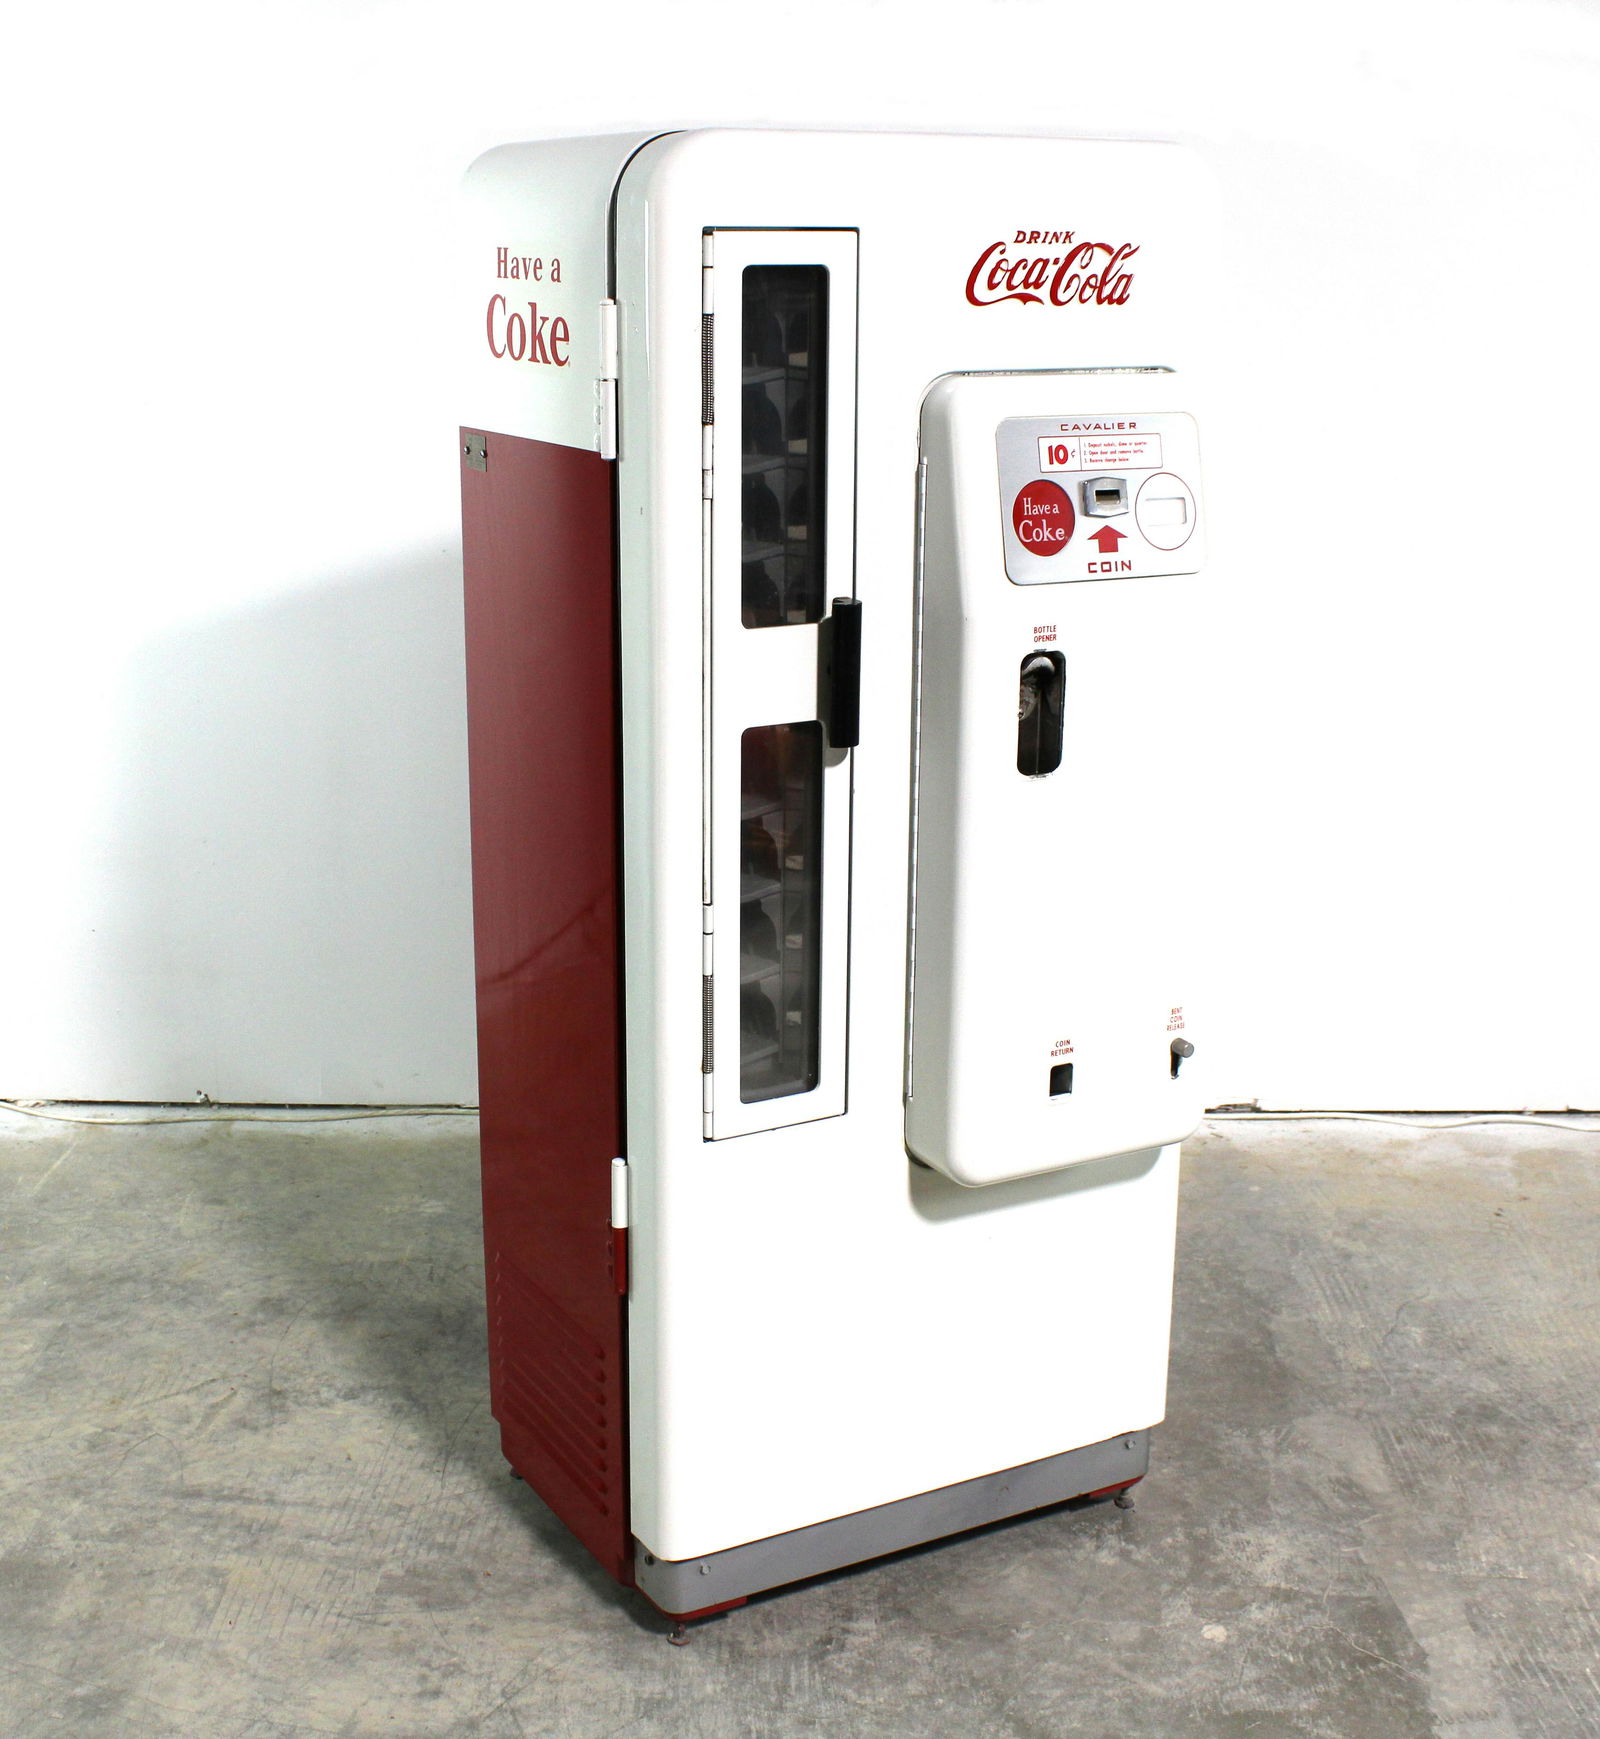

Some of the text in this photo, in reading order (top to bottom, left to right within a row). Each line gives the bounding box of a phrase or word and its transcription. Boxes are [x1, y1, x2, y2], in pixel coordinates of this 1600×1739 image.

[1013, 230, 1075, 245] DRINK
[497, 246, 562, 283] Have a
[966, 241, 1140, 306] Coca-Cola
[486, 293, 570, 367] Coke
[1060, 422, 1137, 431] CAVALIER
[1023, 497, 1060, 516] Have a
[1018, 519, 1065, 543] Coke
[1087, 560, 1132, 574] COIN
[1033, 625, 1057, 634] BOTTLE
[1033, 634, 1057, 643] OPENER
[1169, 1015, 1183, 1023] COIN
[1055, 1040, 1071, 1048] COIN
[1050, 1047, 1074, 1057] RETURN
